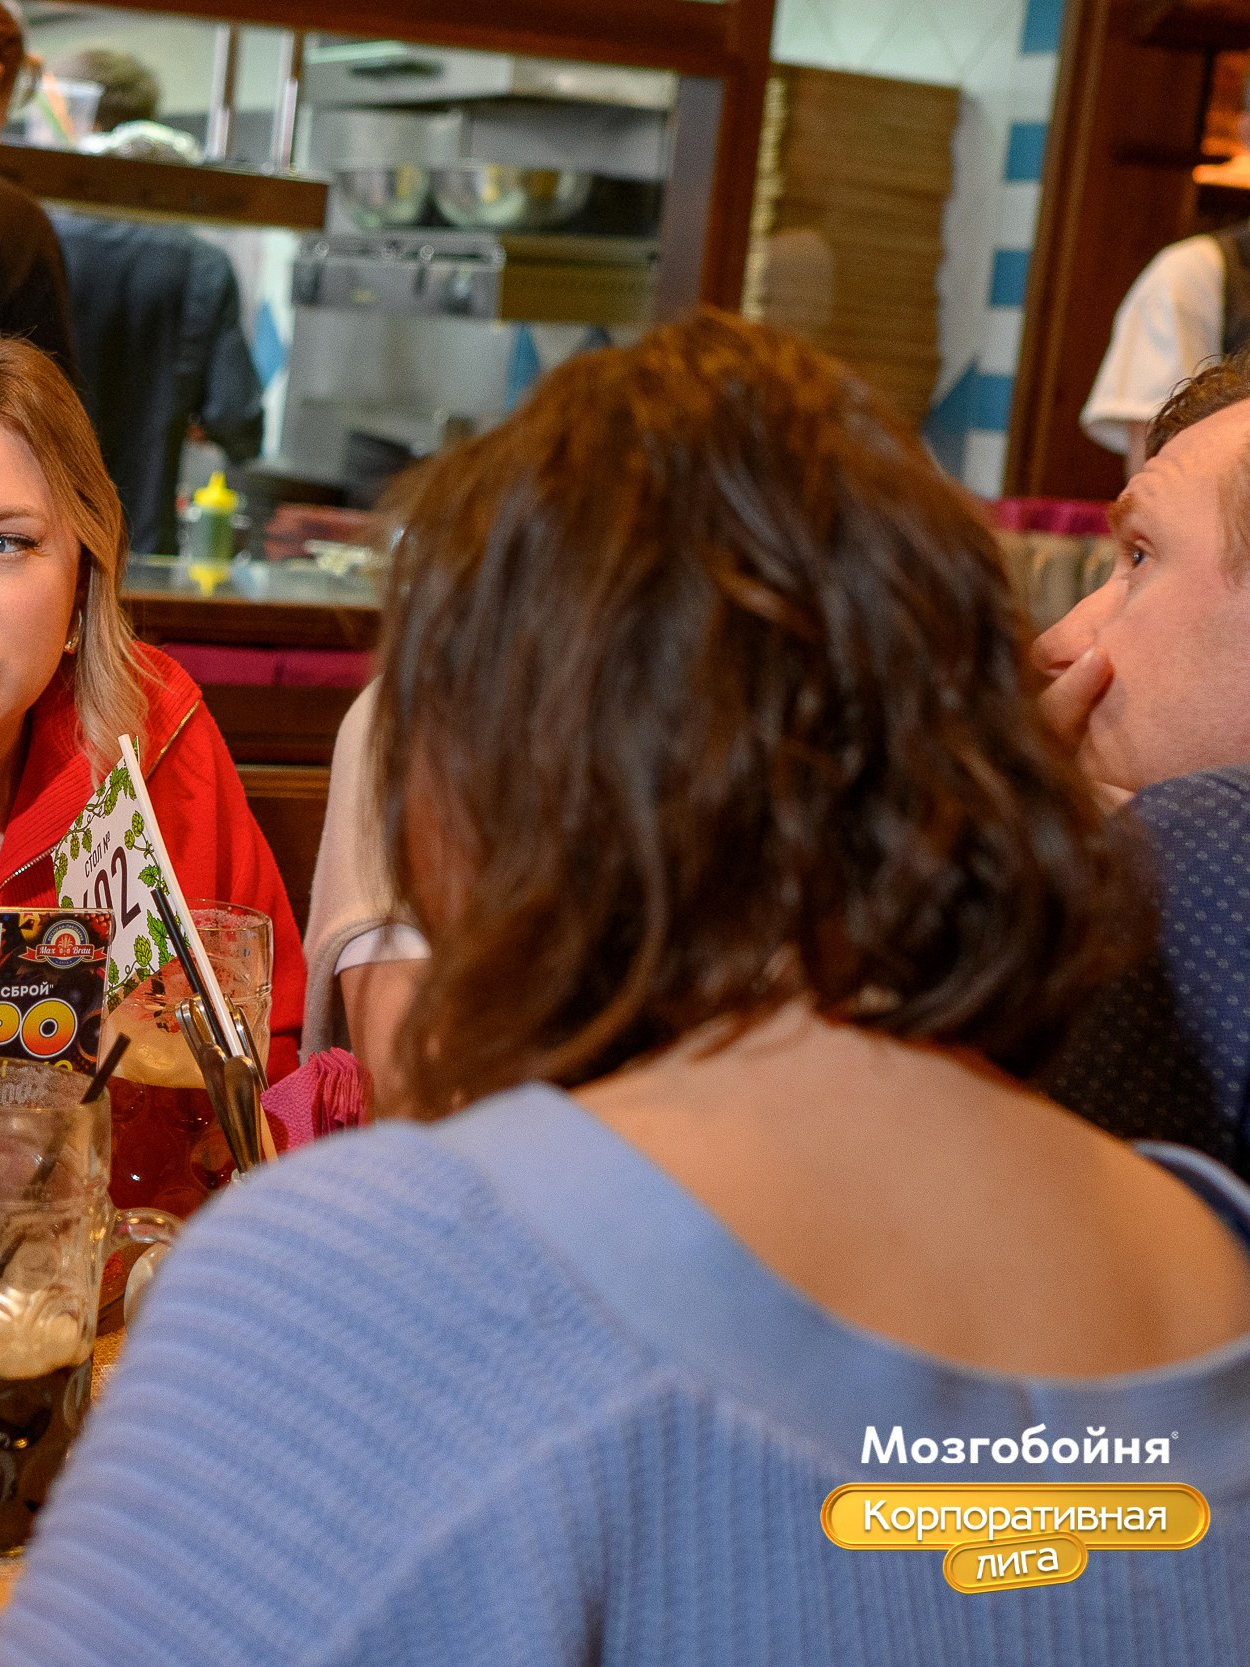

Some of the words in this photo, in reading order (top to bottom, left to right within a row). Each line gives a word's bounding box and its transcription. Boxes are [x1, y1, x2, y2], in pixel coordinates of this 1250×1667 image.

[84, 842, 101, 878] СТОЛ
[83, 846, 142, 944] 02
[39, 946, 56, 954] Max
